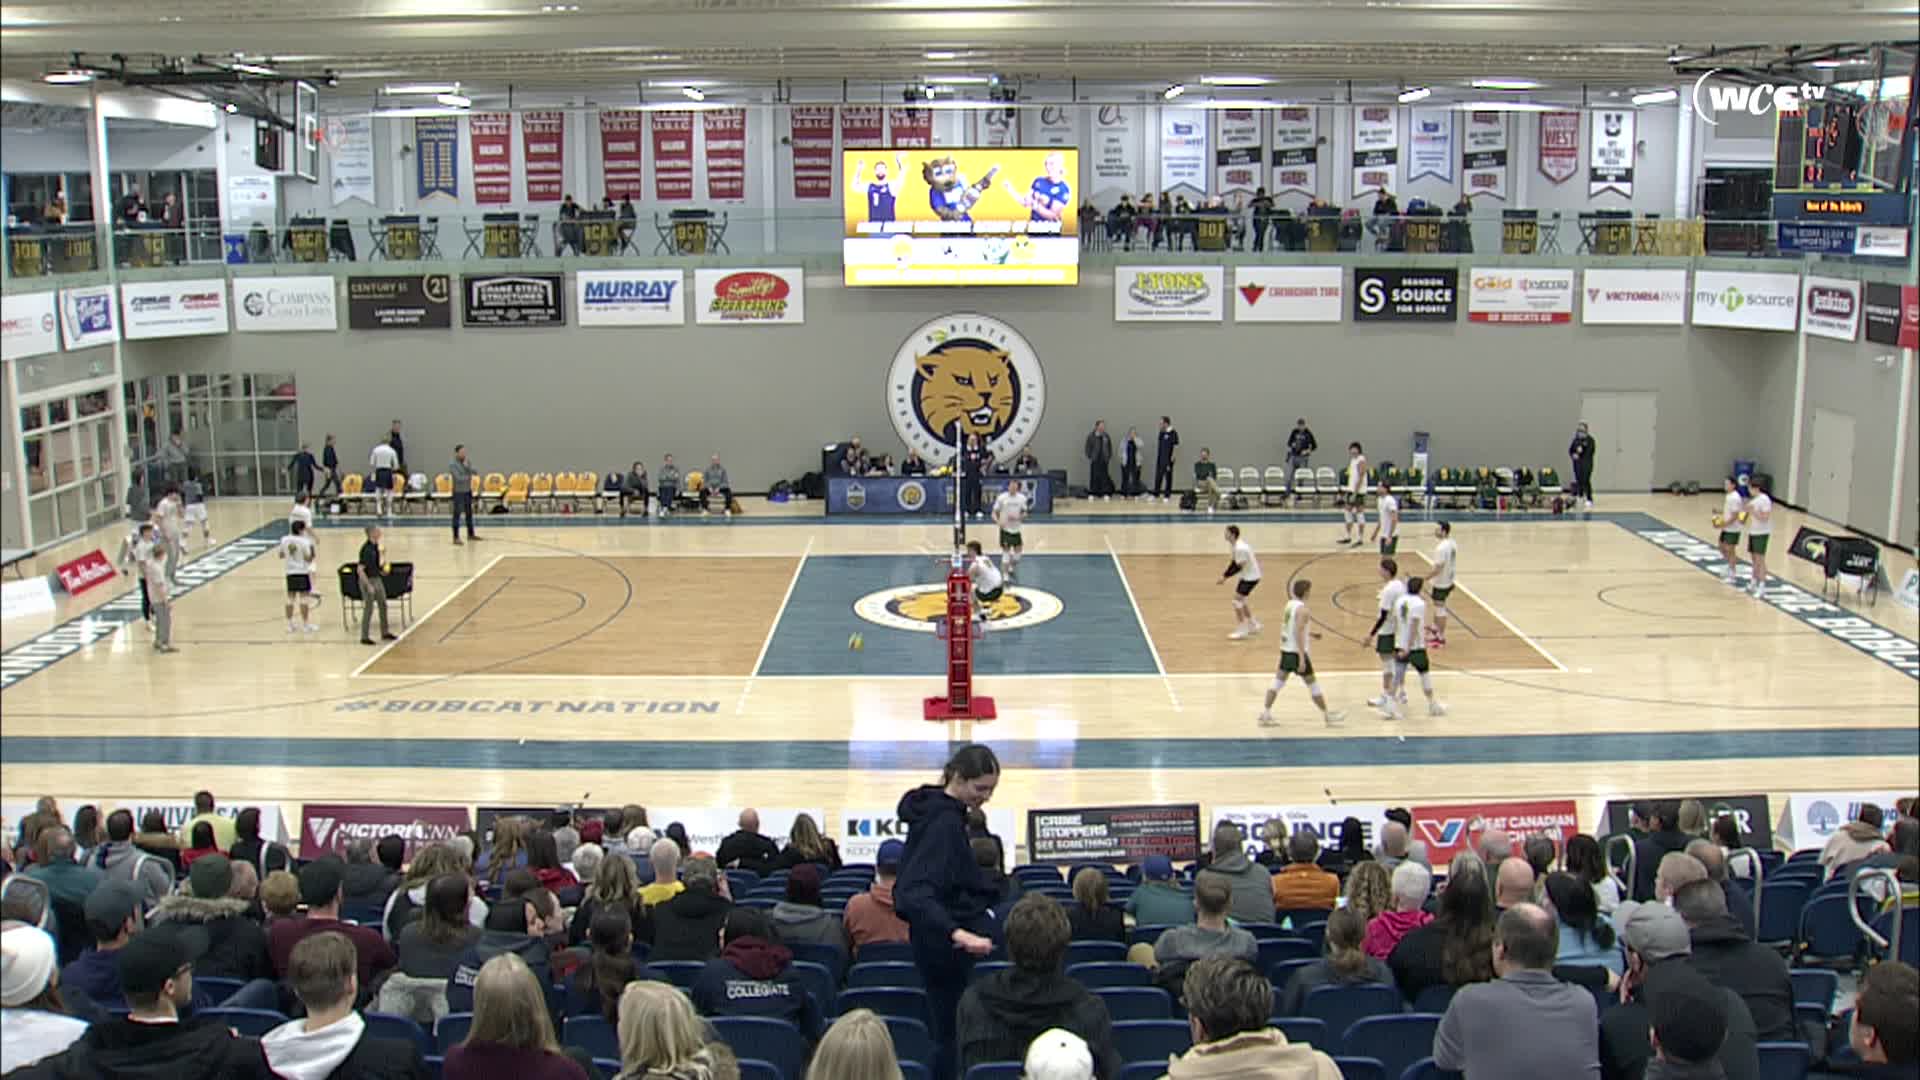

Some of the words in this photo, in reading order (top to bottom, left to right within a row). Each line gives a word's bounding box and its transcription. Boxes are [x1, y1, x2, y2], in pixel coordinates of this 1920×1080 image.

[431, 279, 447, 294] 21
[1136, 272, 1205, 288] LYONS
[351, 282, 396, 293] CENTURY
[585, 280, 678, 300] MURRAY
[1391, 288, 1452, 302] SOURCE
[1605, 291, 1660, 302] VICTORIA
[1696, 291, 1718, 306] my
[1747, 294, 1794, 308] source
[548, 700, 721, 714] NATION
[1041, 814, 1083, 826] CRIME
[1508, 813, 1576, 830] CANADIAN
[1041, 824, 1108, 838] STOPPERS
[1056, 838, 1119, 849] SOMETHING?
[727, 983, 790, 1000] COLLEGIATE
